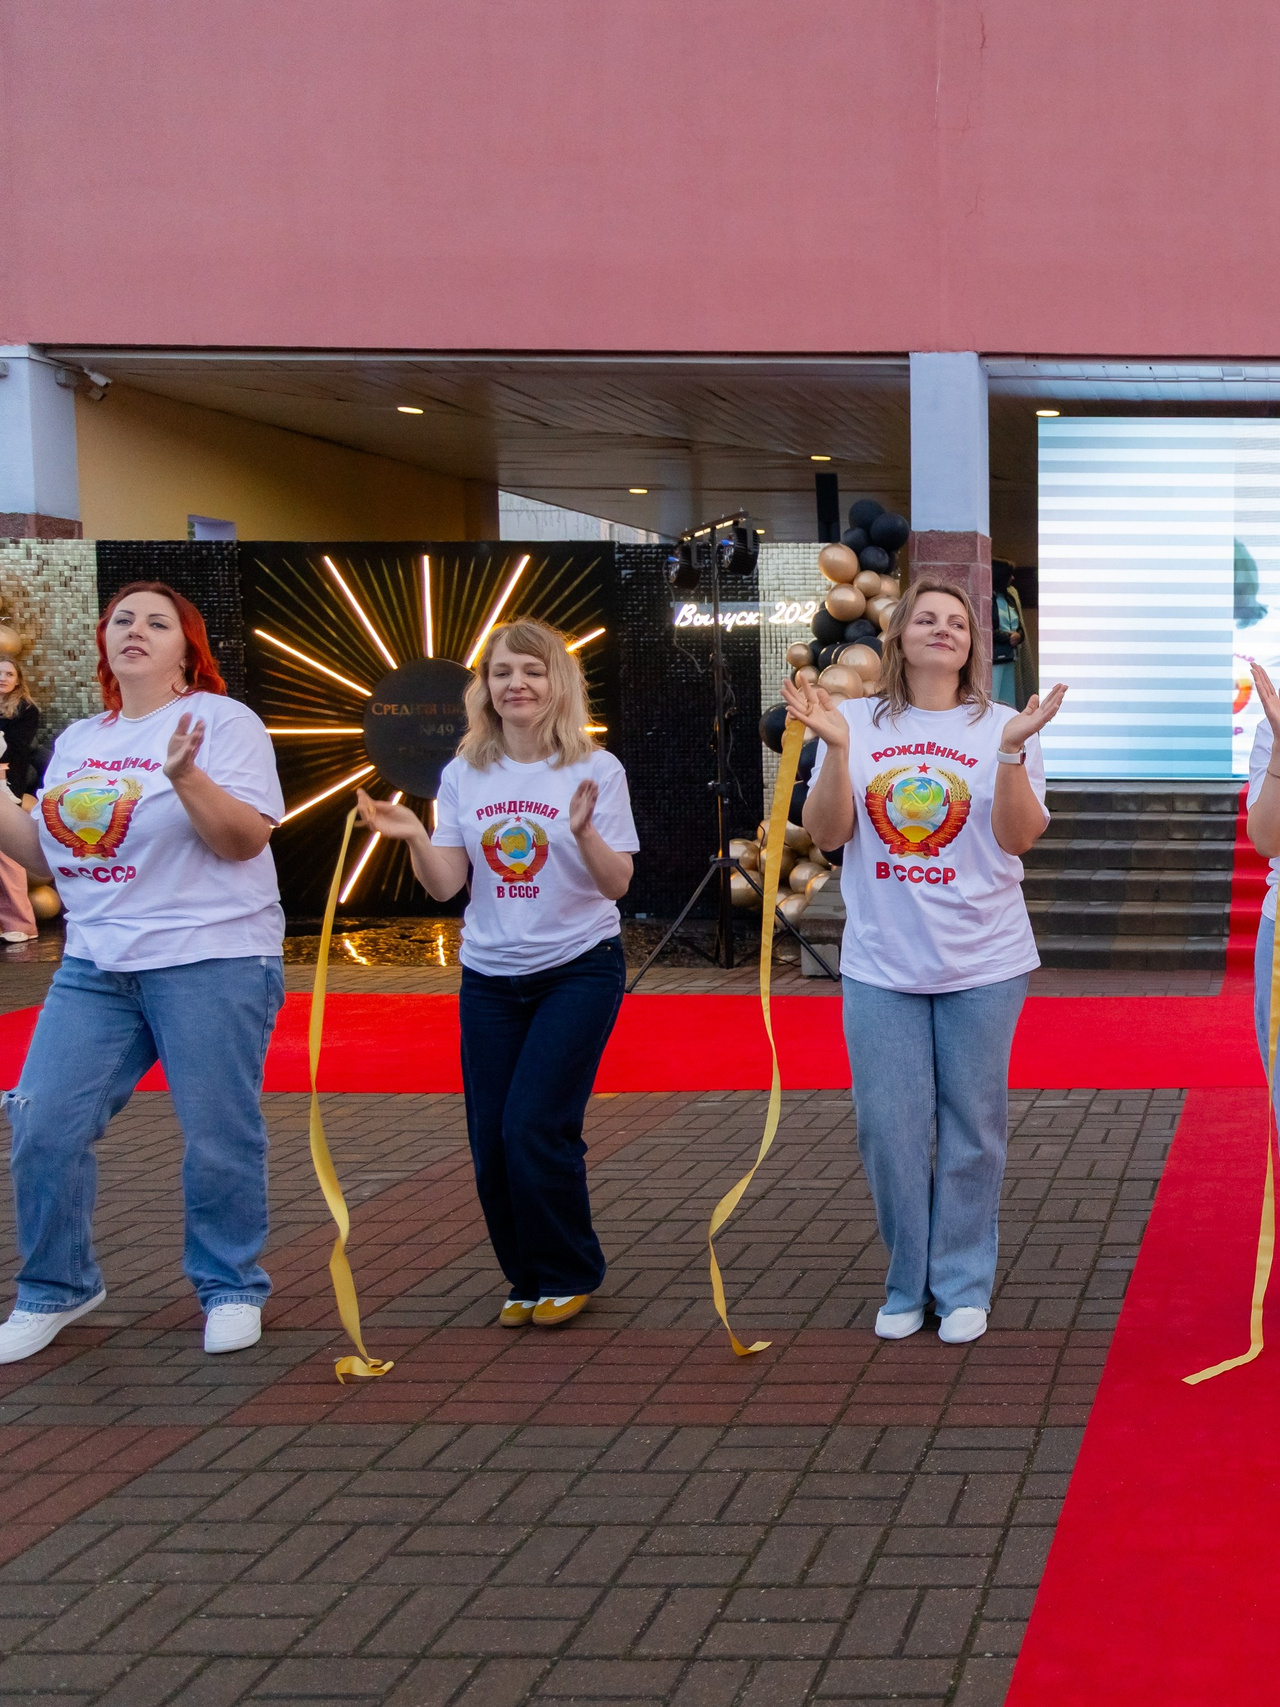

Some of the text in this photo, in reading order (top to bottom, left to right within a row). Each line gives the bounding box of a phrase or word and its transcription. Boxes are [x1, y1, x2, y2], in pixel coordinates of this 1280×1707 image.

[768, 601, 817, 624] 202
[871, 741, 979, 769] РОЖДЁННАЯ
[476, 800, 560, 821] РОЖДЕННАЯ
[78, 865, 137, 883] СССР
[875, 861, 956, 885] В СССР
[496, 885, 540, 899] В СССР
